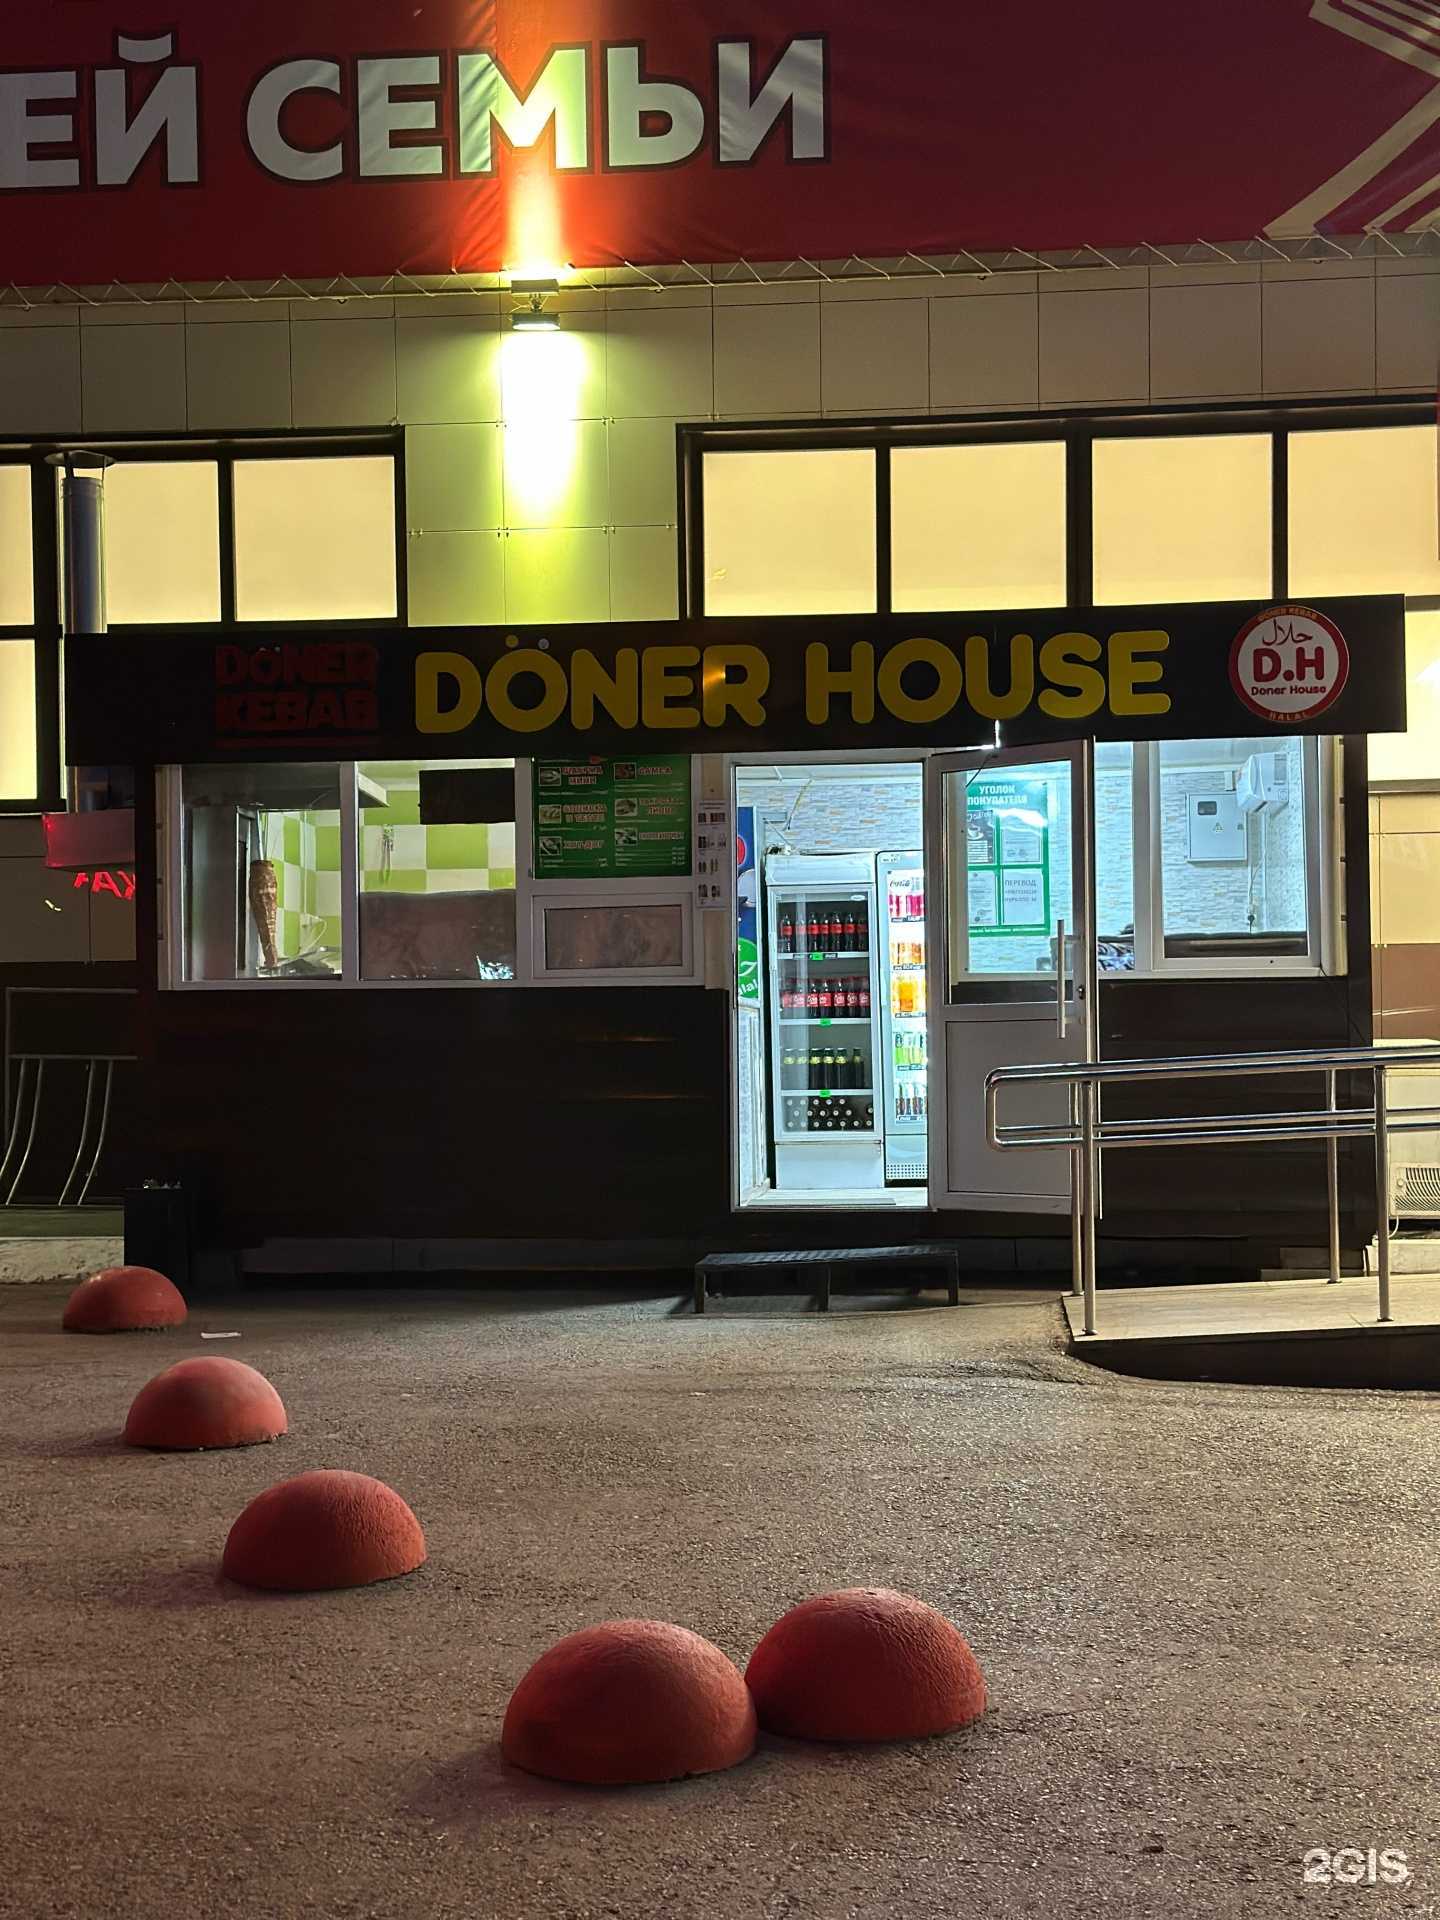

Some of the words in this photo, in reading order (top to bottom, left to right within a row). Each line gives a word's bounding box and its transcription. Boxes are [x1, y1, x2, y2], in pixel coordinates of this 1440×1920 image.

[247, 38, 825, 181] СЕМЬИ
[414, 634, 770, 734] DÖNER
[805, 630, 1171, 725] HOUSE
[1253, 646, 1325, 683] D.H
[1251, 685, 1286, 696] Doner
[1289, 683, 1327, 695] House
[215, 689, 379, 731] KEBAB
[979, 784, 1016, 795] УГОЛОК
